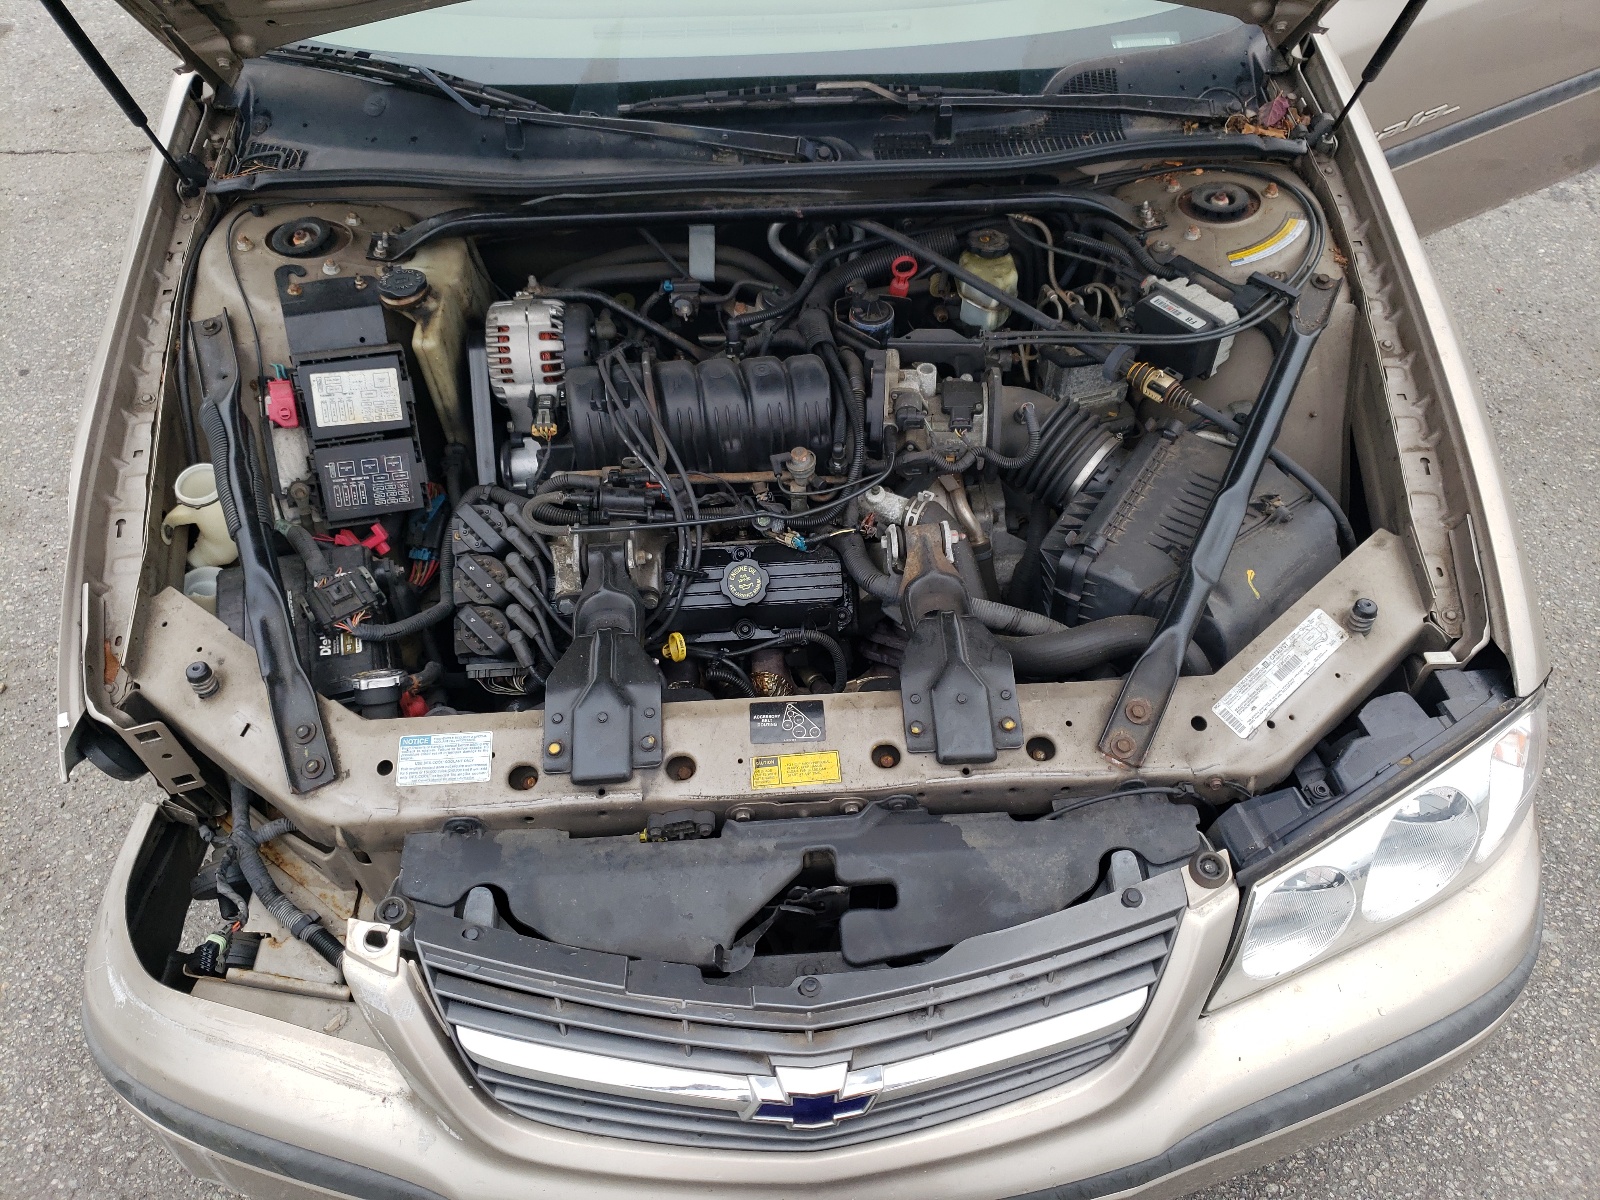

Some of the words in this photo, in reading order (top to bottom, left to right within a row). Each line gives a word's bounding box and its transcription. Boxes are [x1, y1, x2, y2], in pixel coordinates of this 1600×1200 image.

[729, 565, 748, 581] ENGINE
[748, 567, 757, 576] OIL
[1269, 641, 1289, 661] CATALYST
